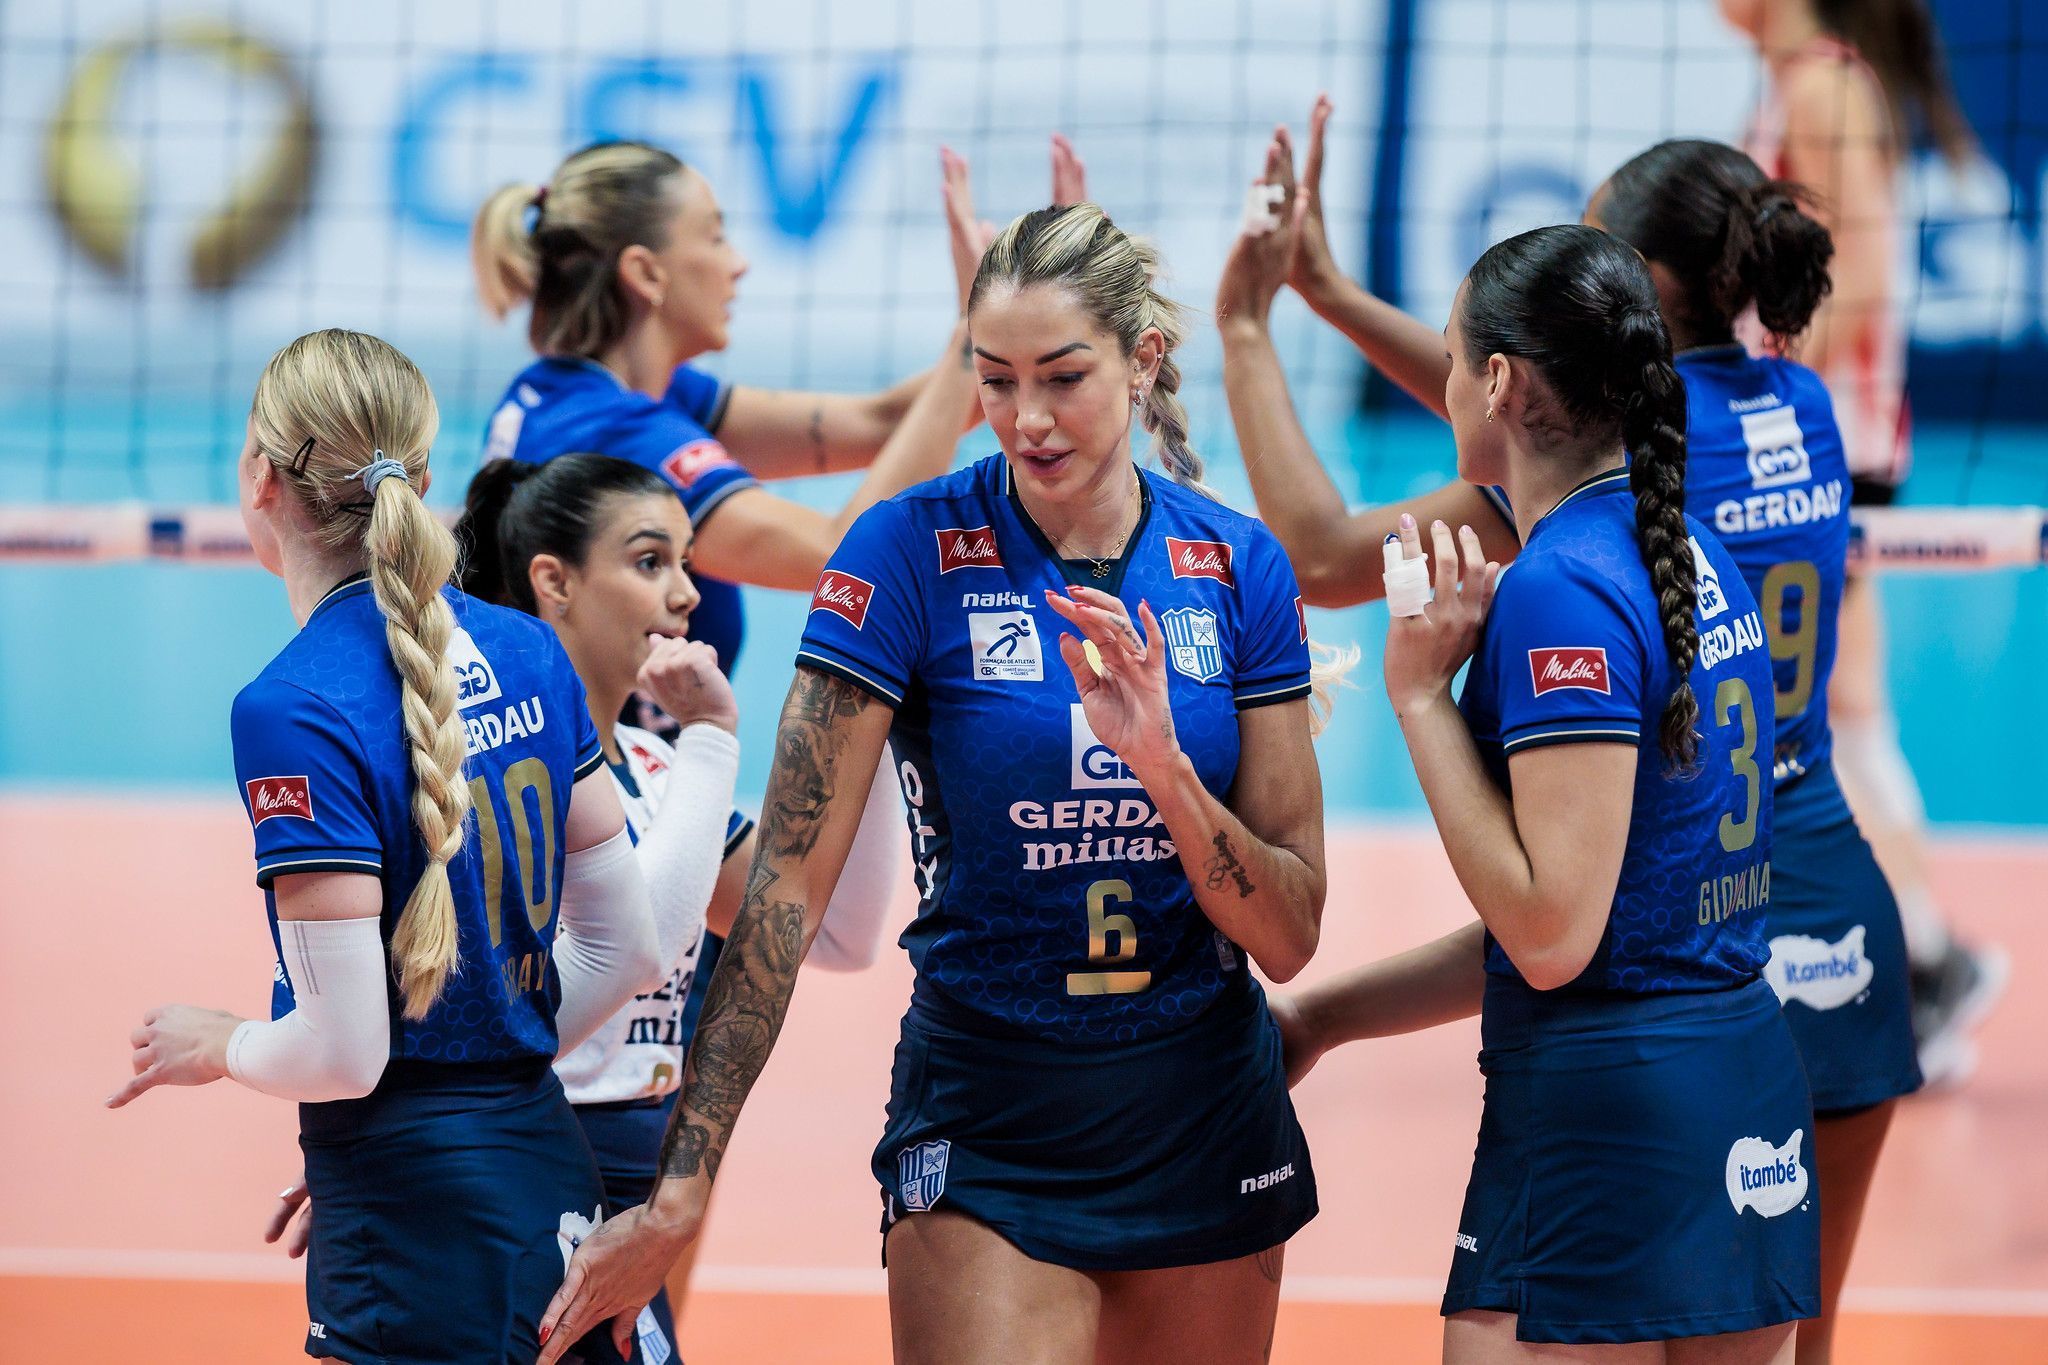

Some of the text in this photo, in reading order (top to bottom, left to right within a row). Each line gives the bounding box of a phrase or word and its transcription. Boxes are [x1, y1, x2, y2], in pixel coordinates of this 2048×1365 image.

[1714, 479, 1842, 534] GERDAU
[947, 533, 997, 561] Melitta
[1179, 546, 1226, 573] Melitta
[815, 576, 857, 611] Melitta
[981, 667, 998, 676] CBC
[1540, 654, 1599, 682] Melitta
[464, 696, 545, 758] ERDAU
[1715, 677, 1761, 852] 3
[256, 784, 301, 813] Melitta
[1009, 799, 1165, 829] GERD
[467, 757, 556, 950] 10
[1023, 832, 1178, 870] minas
[1086, 879, 1138, 963] 6
[1784, 950, 1859, 985] itambé
[1740, 1154, 1797, 1192] itambé
